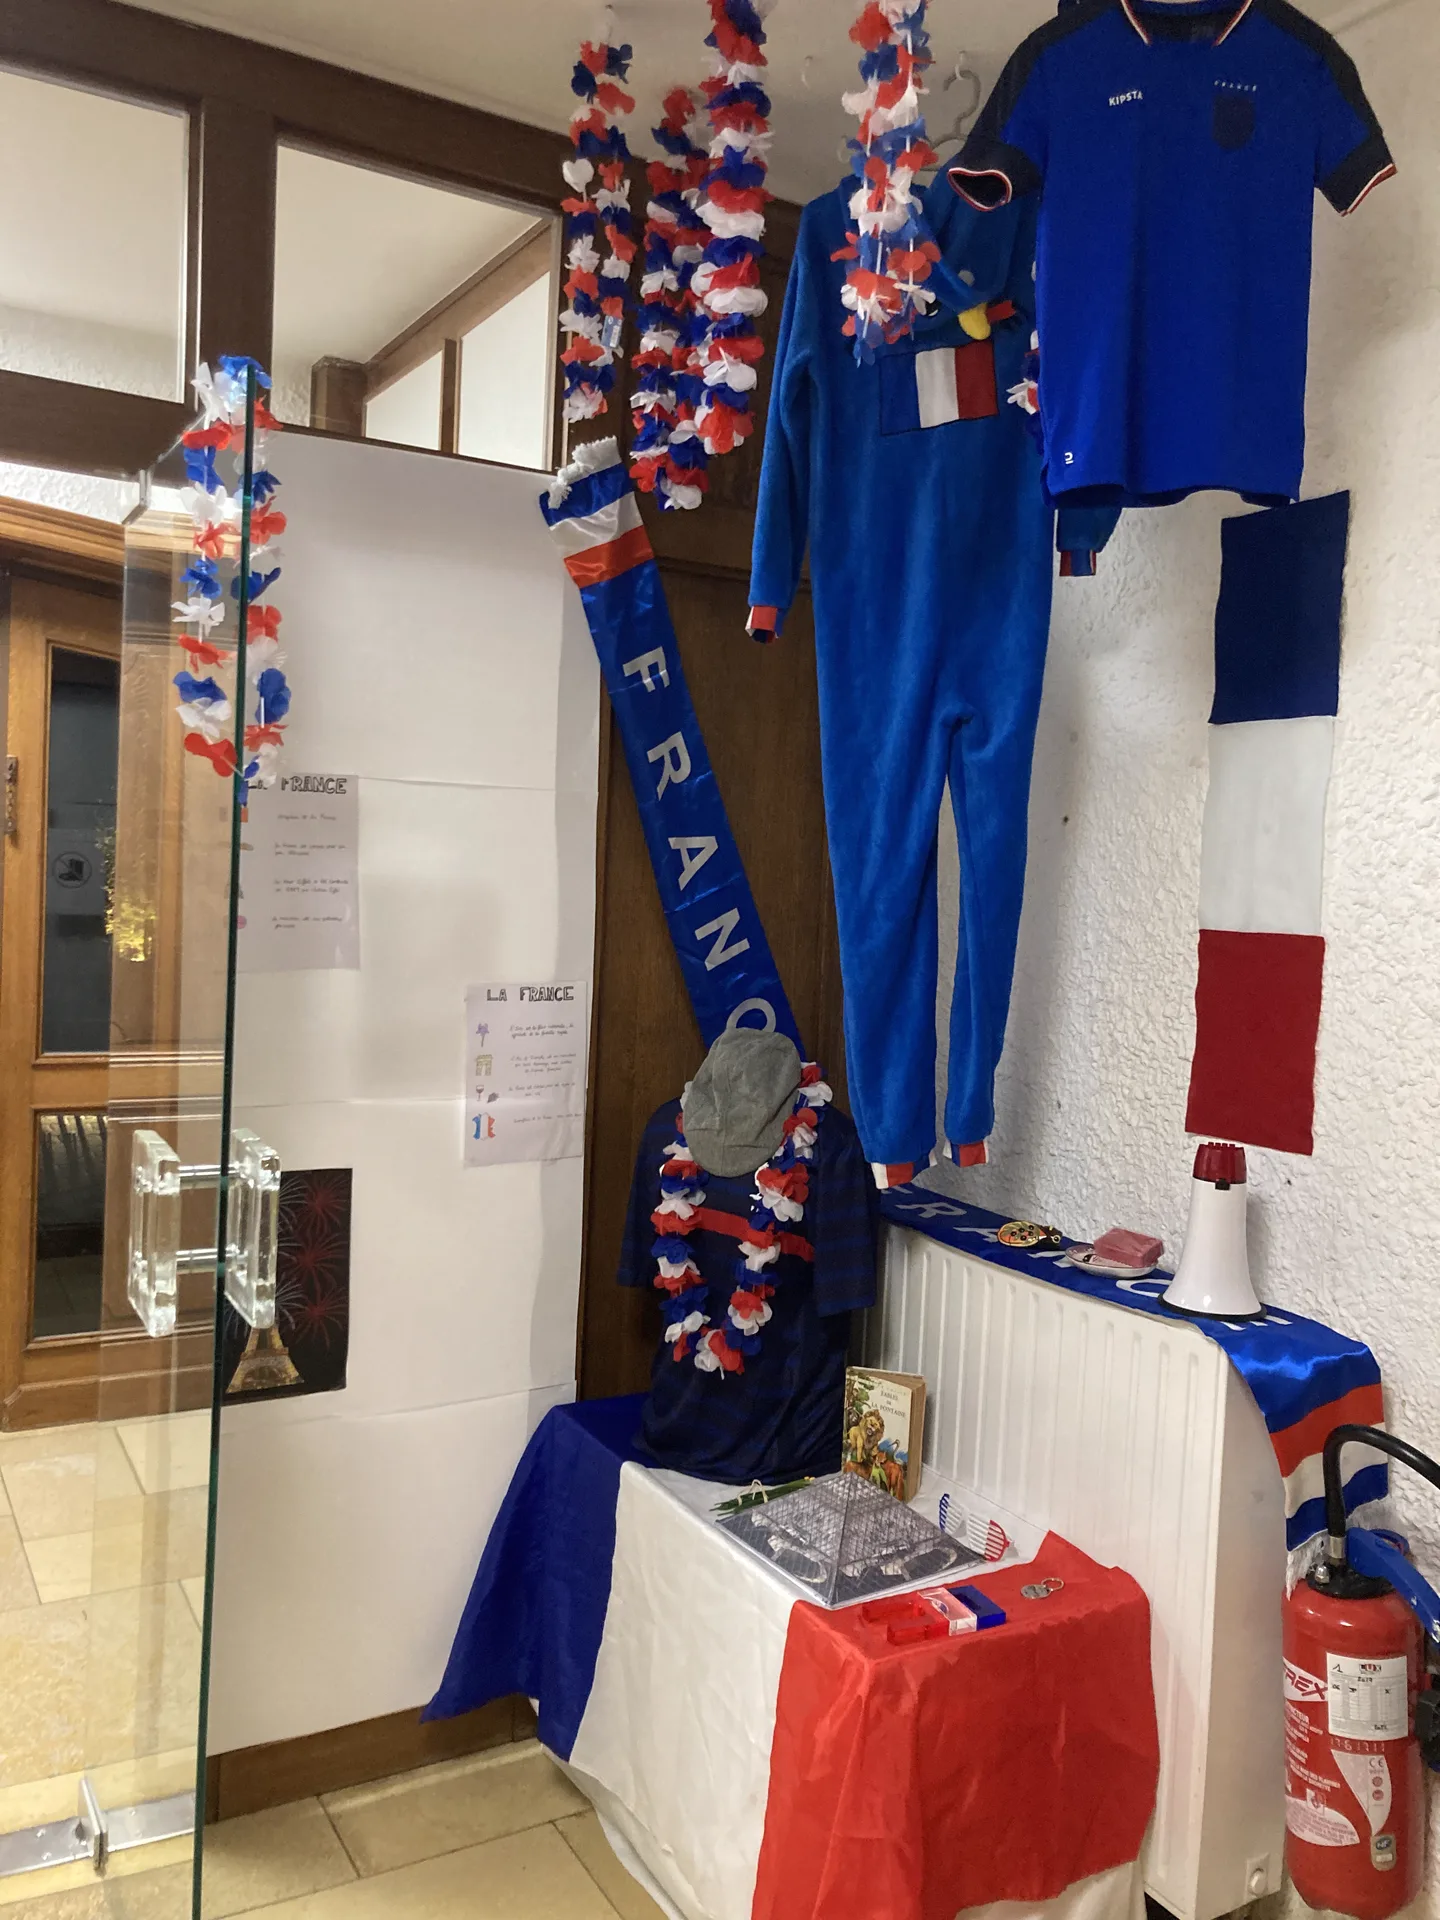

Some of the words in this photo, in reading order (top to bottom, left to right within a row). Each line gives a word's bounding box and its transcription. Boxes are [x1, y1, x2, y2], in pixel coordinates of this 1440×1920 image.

[1108, 89, 1144, 107] KIPSTA
[622, 645, 778, 1035] FRANC
[486, 989, 507, 1001] LA
[519, 986, 574, 1002] FRANCE
